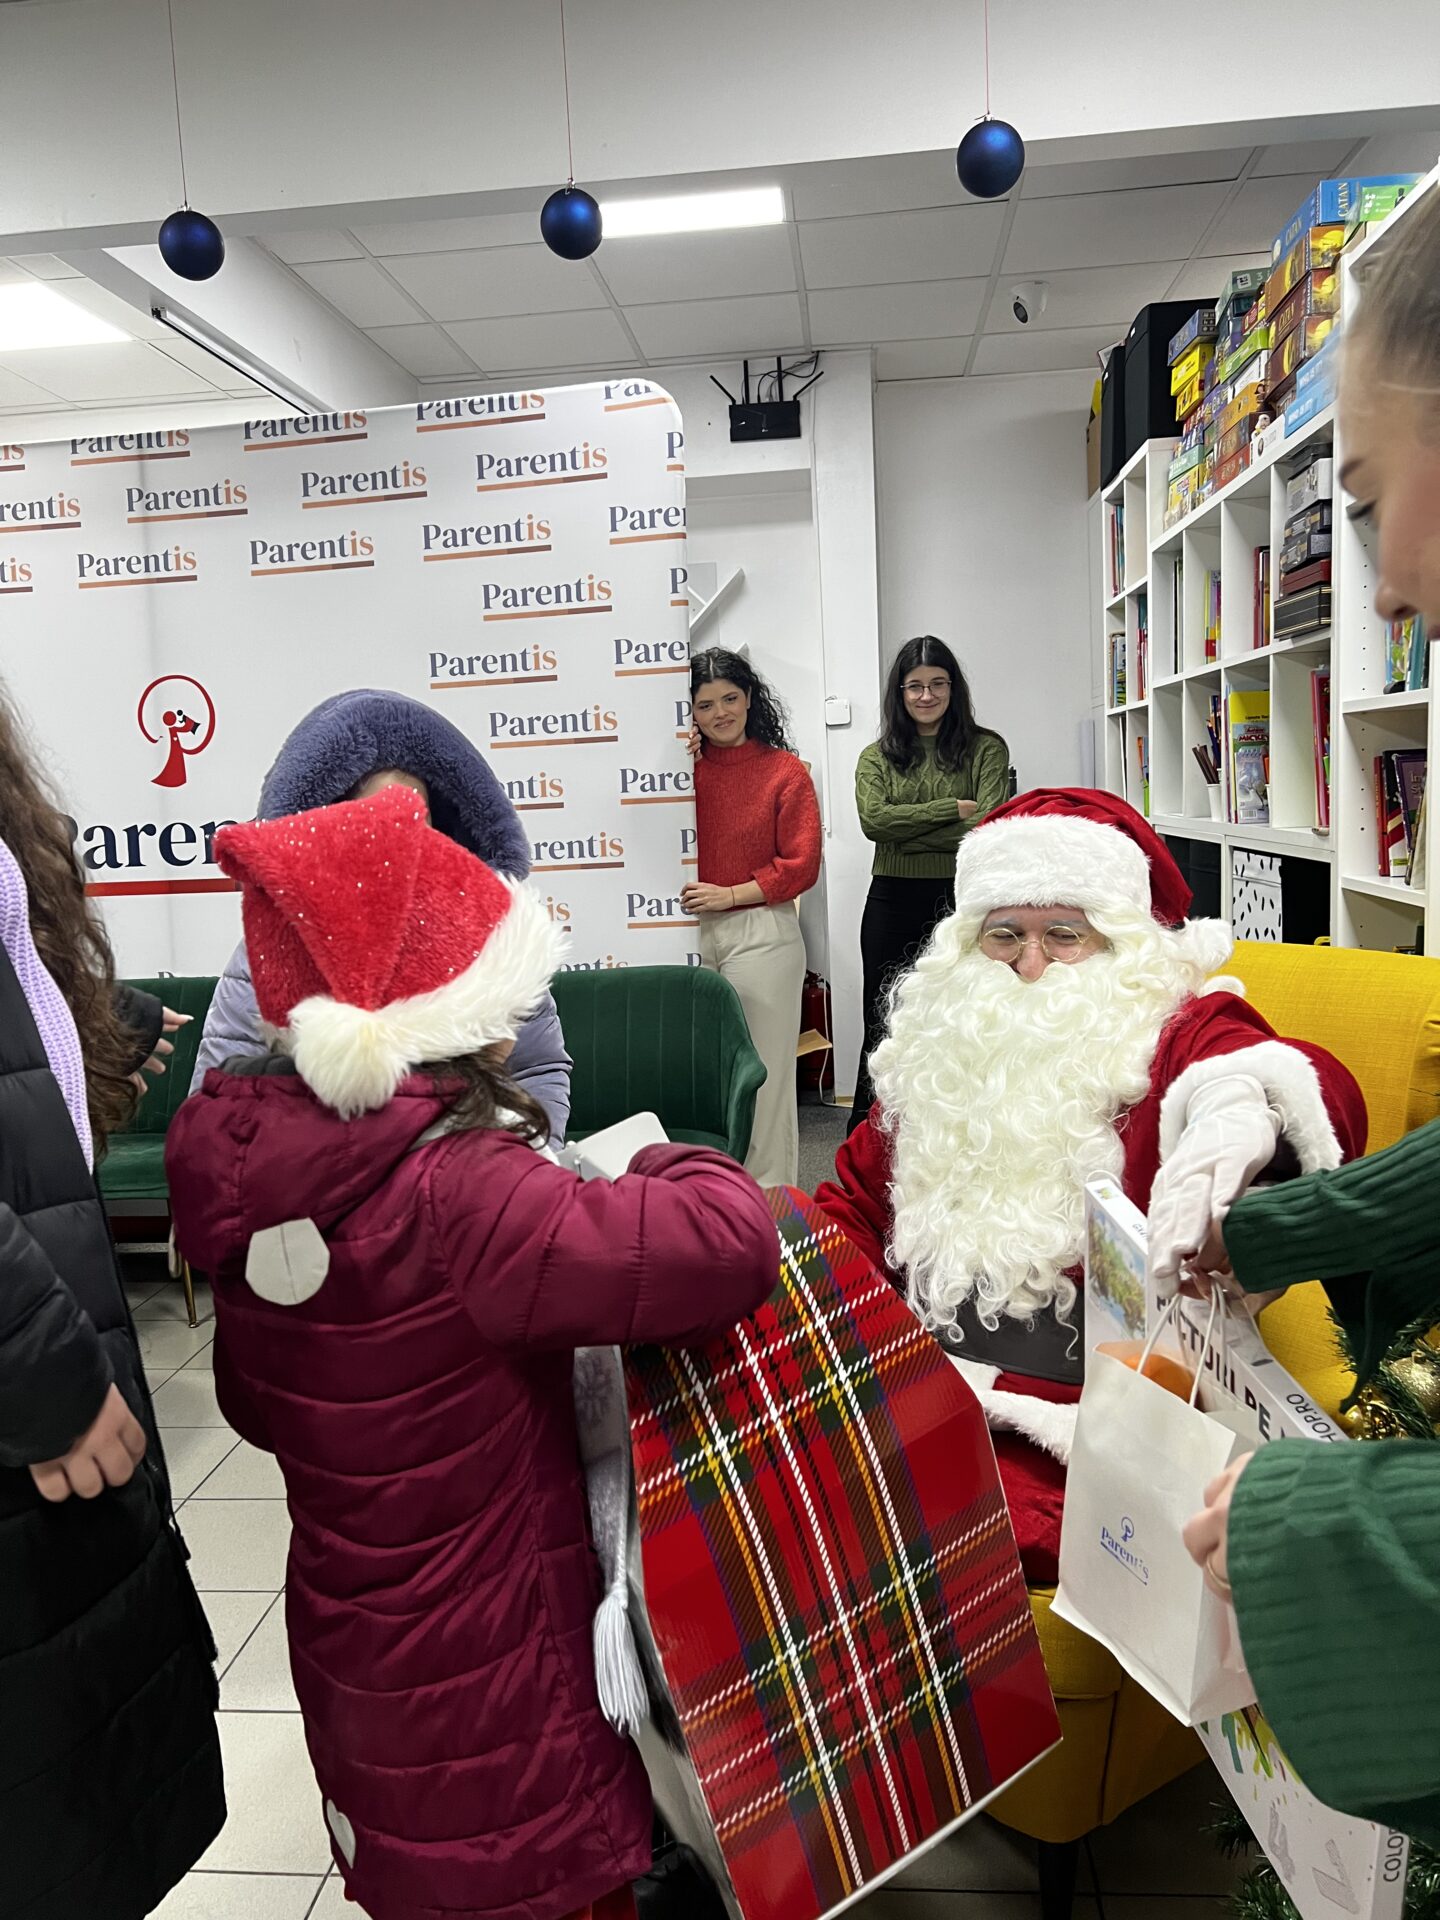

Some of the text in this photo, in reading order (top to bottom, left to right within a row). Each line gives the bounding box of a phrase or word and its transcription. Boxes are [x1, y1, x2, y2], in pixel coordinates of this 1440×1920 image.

[1338, 182, 1349, 217] CATAN
[475, 442, 608, 481] Parentis
[126, 479, 248, 513] Parentis
[301, 461, 428, 498] Parentis
[249, 530, 375, 565] Parentis
[422, 514, 552, 550] Parentis
[77, 545, 198, 578] Parentis
[482, 574, 613, 609] Parentis
[429, 644, 558, 678] Parentis
[489, 705, 619, 738] Parentis
[500, 772, 565, 800] ntis
[620, 768, 695, 794] Pare
[531, 832, 625, 861] rentis
